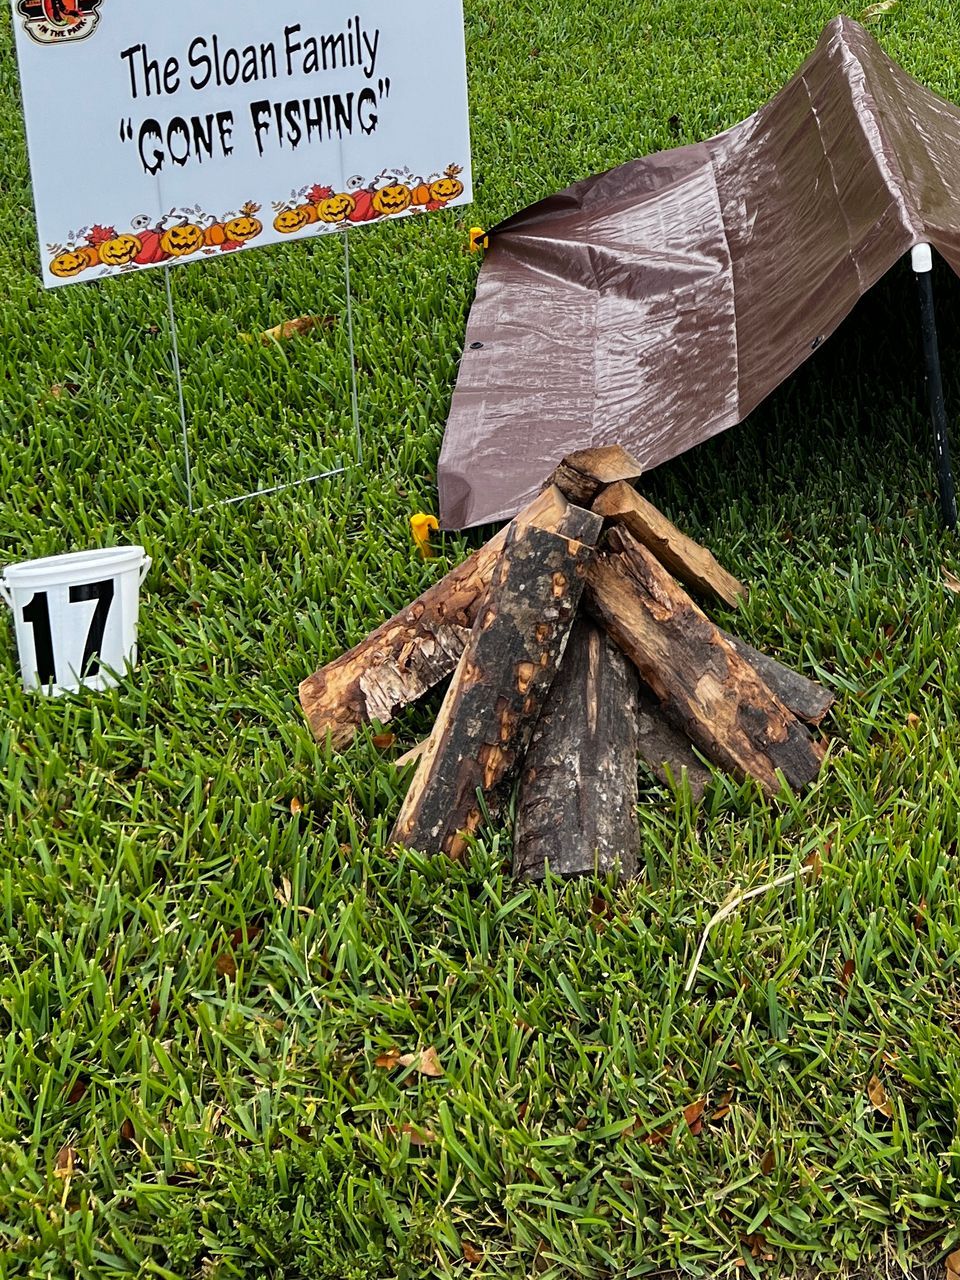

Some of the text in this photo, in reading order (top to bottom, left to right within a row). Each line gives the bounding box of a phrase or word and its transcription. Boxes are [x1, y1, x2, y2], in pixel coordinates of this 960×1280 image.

[39, 19, 86, 37] IN THE PARK
[120, 15, 380, 99] The Sloan Family
[22, 578, 115, 686] 17
